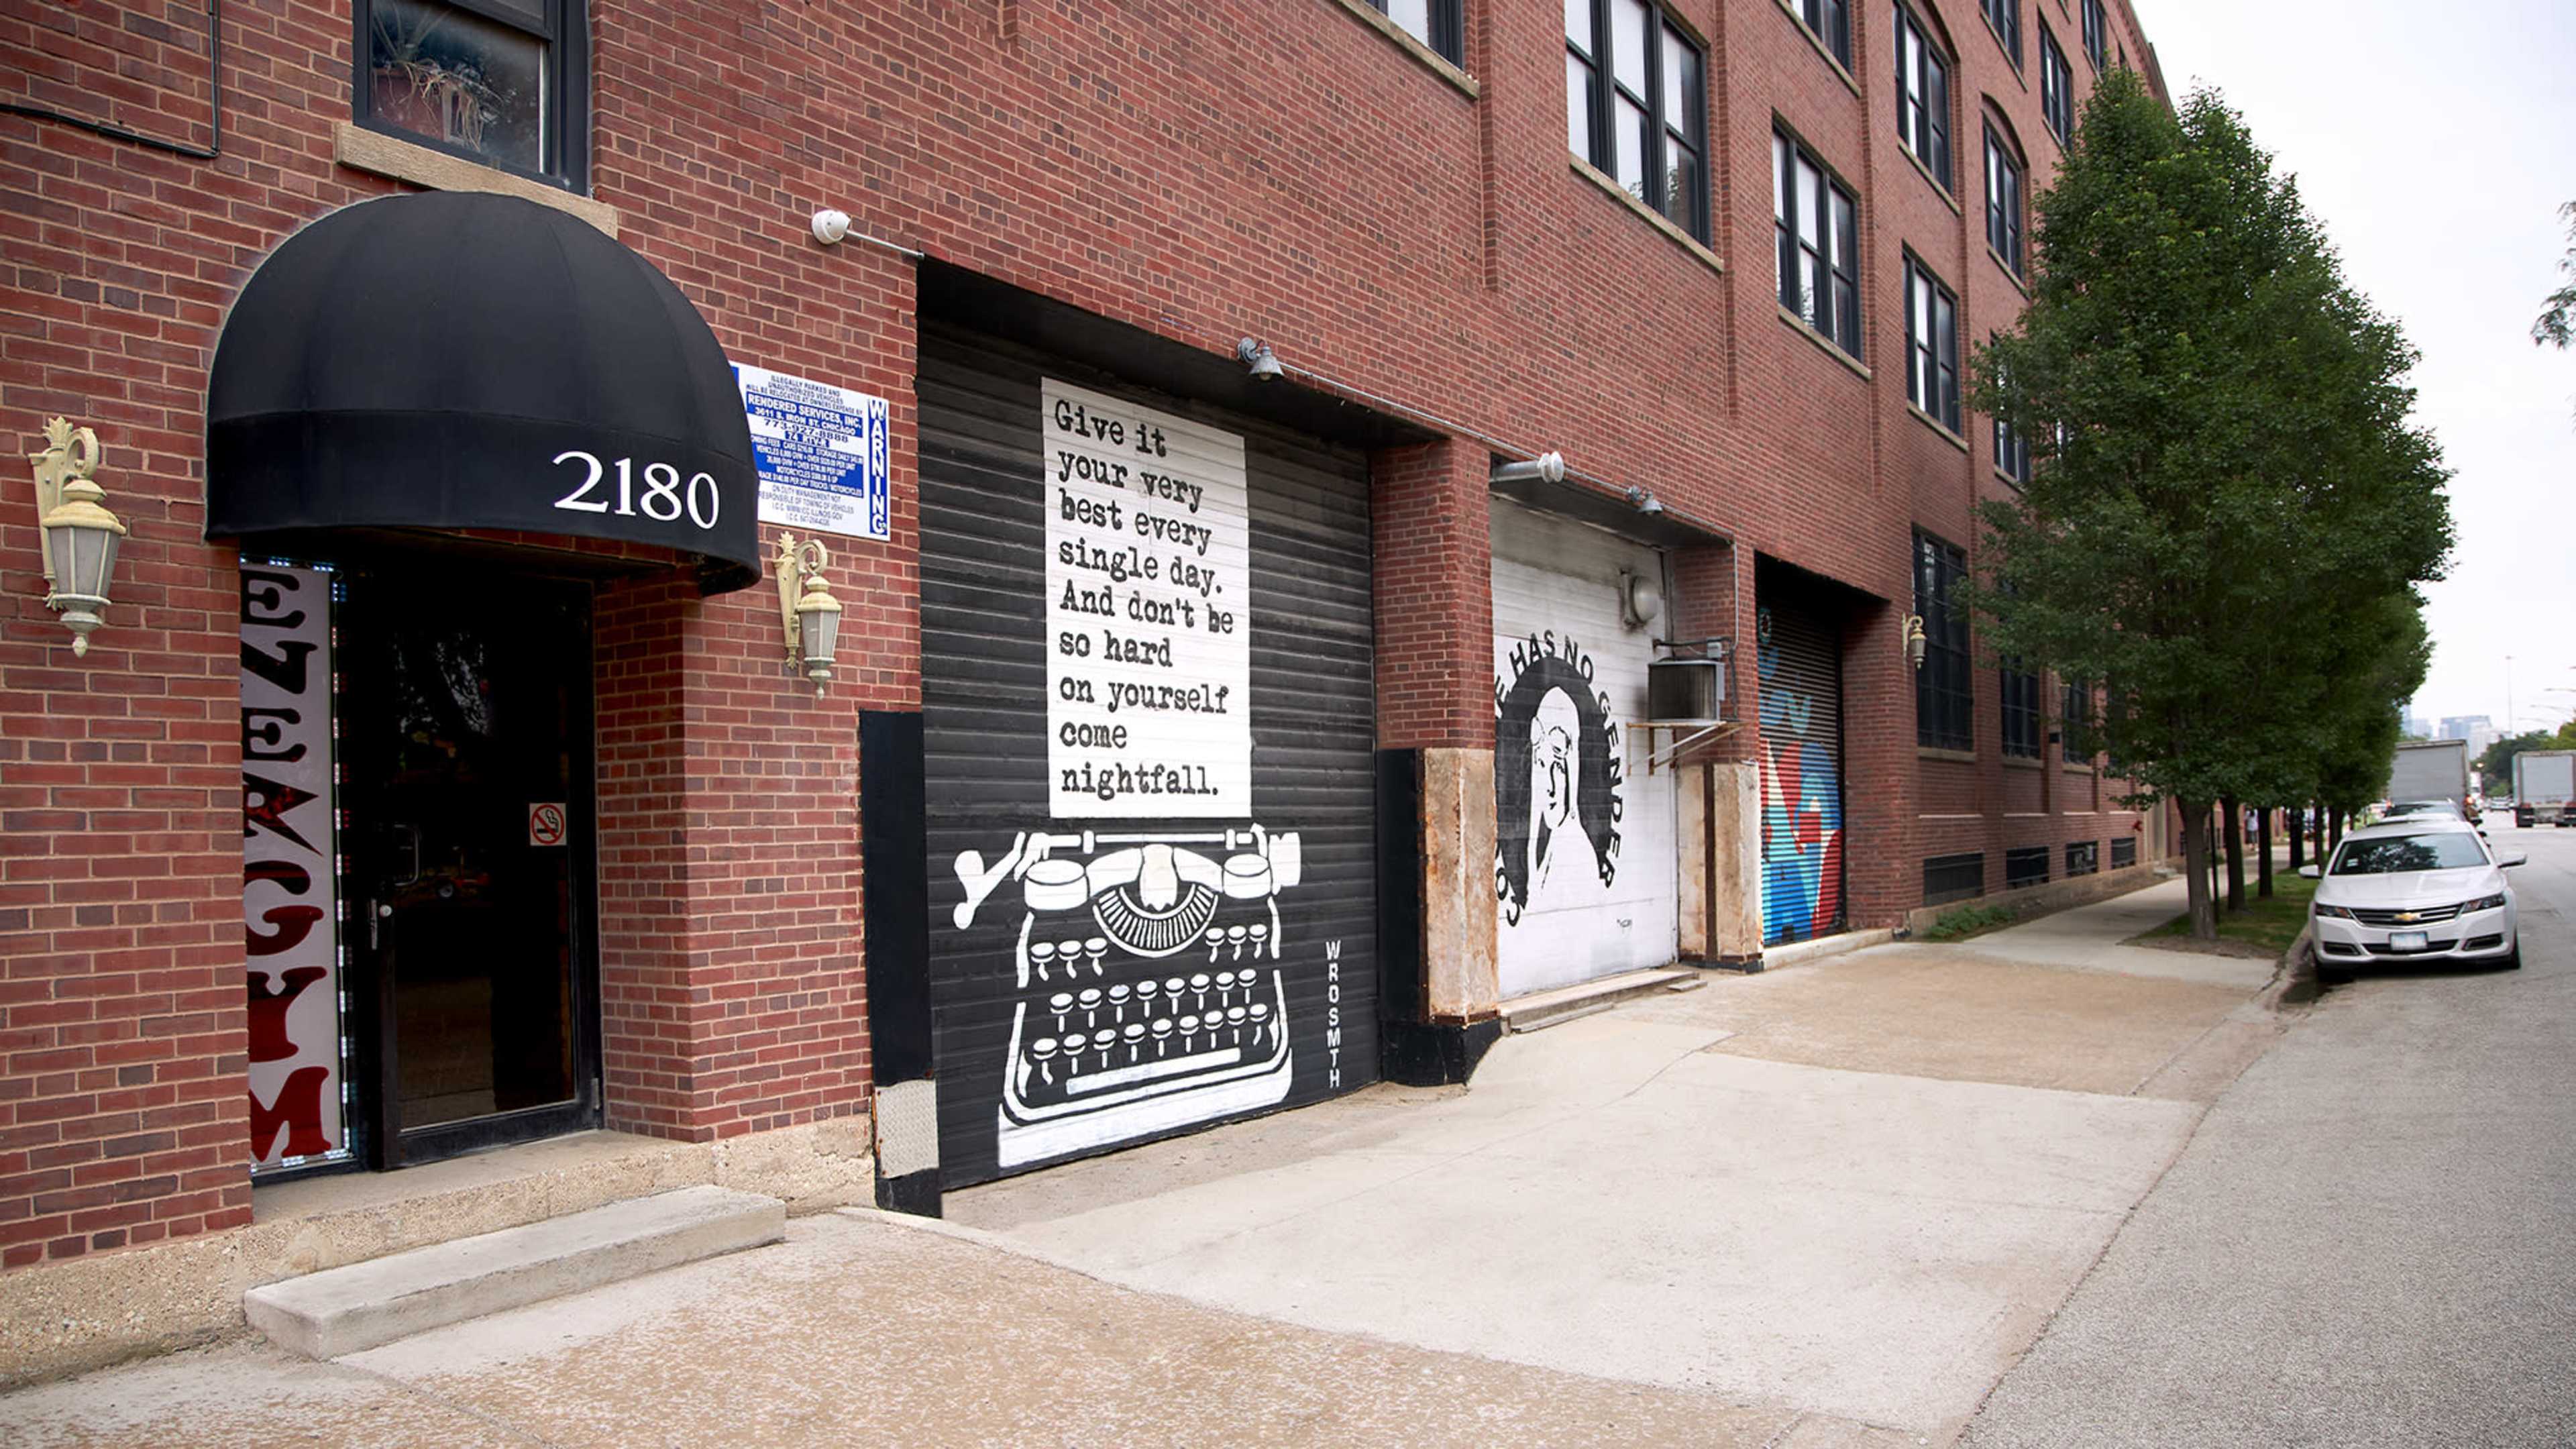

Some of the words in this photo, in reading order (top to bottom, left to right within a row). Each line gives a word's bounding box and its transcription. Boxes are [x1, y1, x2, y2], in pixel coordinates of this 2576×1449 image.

[748, 393, 797, 413] RENDERED
[1055, 399, 1125, 445] Give
[1136, 423, 1167, 458] it
[552, 451, 720, 529] 2180
[869, 400, 886, 533] WARNING
[1058, 451, 1128, 488] your
[1140, 472, 1203, 514] very
[1059, 488, 1122, 531] best
[1134, 513, 1212, 555] every
[1060, 538, 1157, 583] single
[1171, 557, 1222, 597] day.
[1060, 579, 1115, 616] And
[1128, 590, 1194, 629] don't
[1208, 604, 1233, 634] be
[1060, 632, 1090, 657] so
[1104, 630, 1173, 667] hard
[1060, 677, 1095, 703] on
[1108, 682, 1229, 713] yourself
[1060, 722, 1127, 748] come
[1509, 629, 1556, 680] HAS
[1564, 635, 1593, 684] NO
[1598, 691, 1623, 889] GENDER
[1061, 762, 1218, 801] nightfall.
